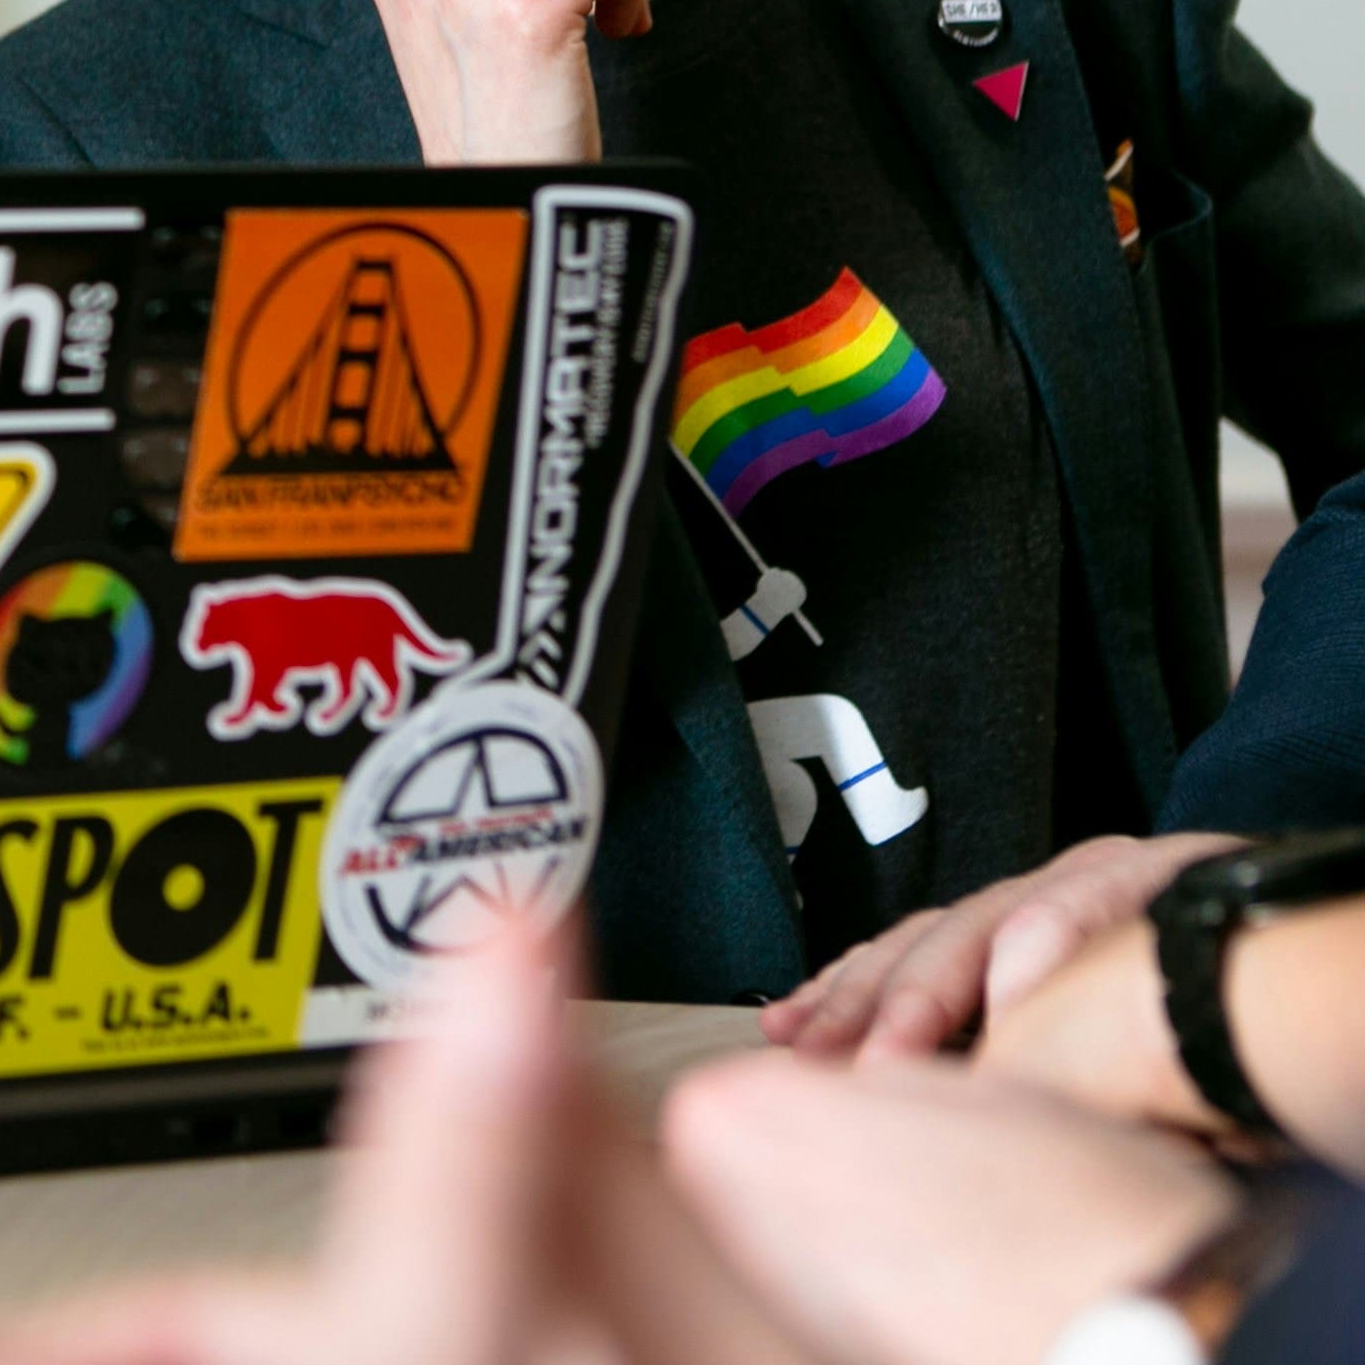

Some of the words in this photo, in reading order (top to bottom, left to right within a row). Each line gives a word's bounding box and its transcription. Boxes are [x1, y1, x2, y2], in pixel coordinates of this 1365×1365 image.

[57, 282, 118, 394] LABS
[528, 216, 605, 596] NORMATEC
[100, 980, 253, 1033] U.S.A.
